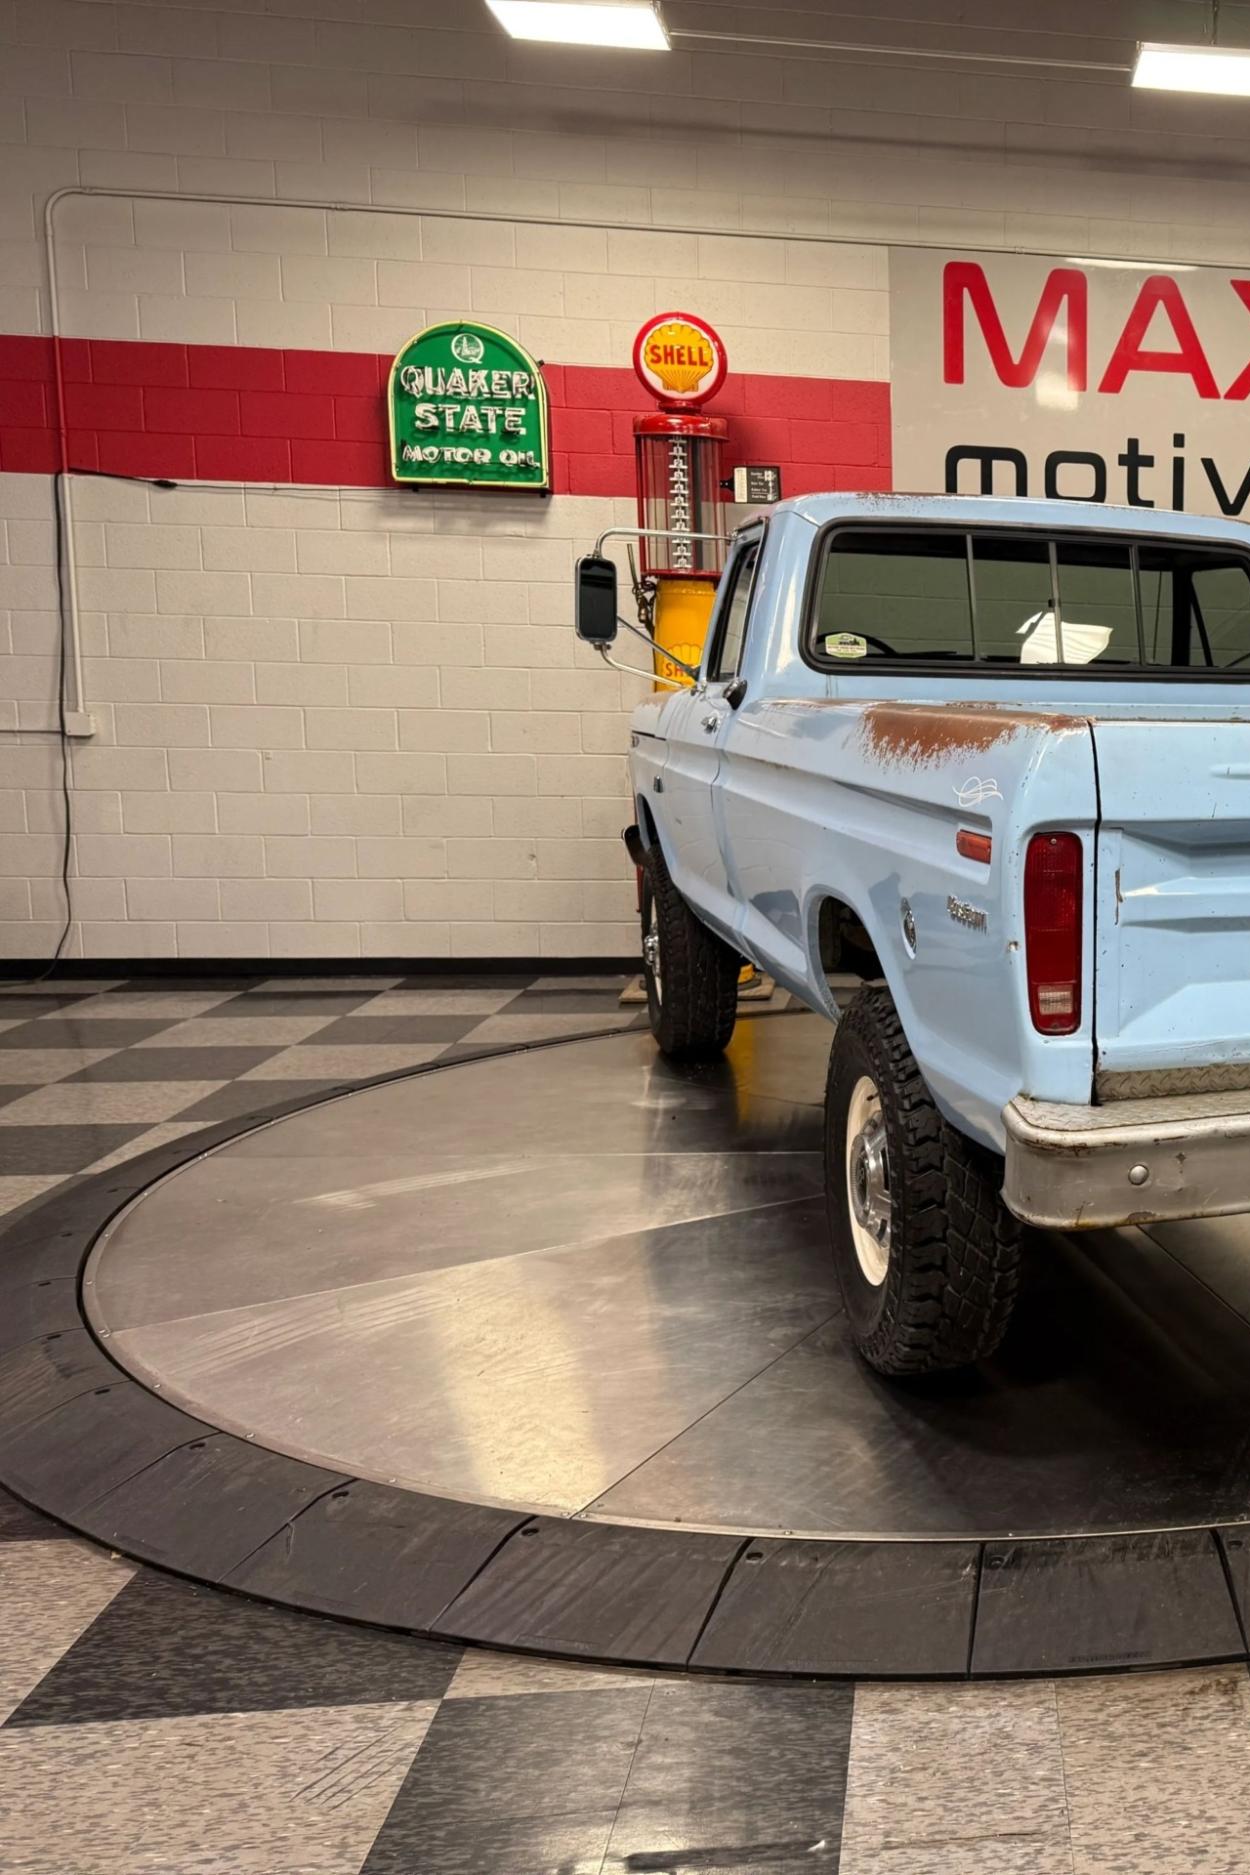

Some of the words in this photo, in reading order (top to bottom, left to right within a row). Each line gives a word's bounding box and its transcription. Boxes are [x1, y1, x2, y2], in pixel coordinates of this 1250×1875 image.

[649, 345, 709, 367] SHELL
[400, 365, 535, 399] QUAKER
[415, 402, 526, 434] STATE
[402, 444, 491, 464] MOTOR
[499, 449, 540, 467] OIL
